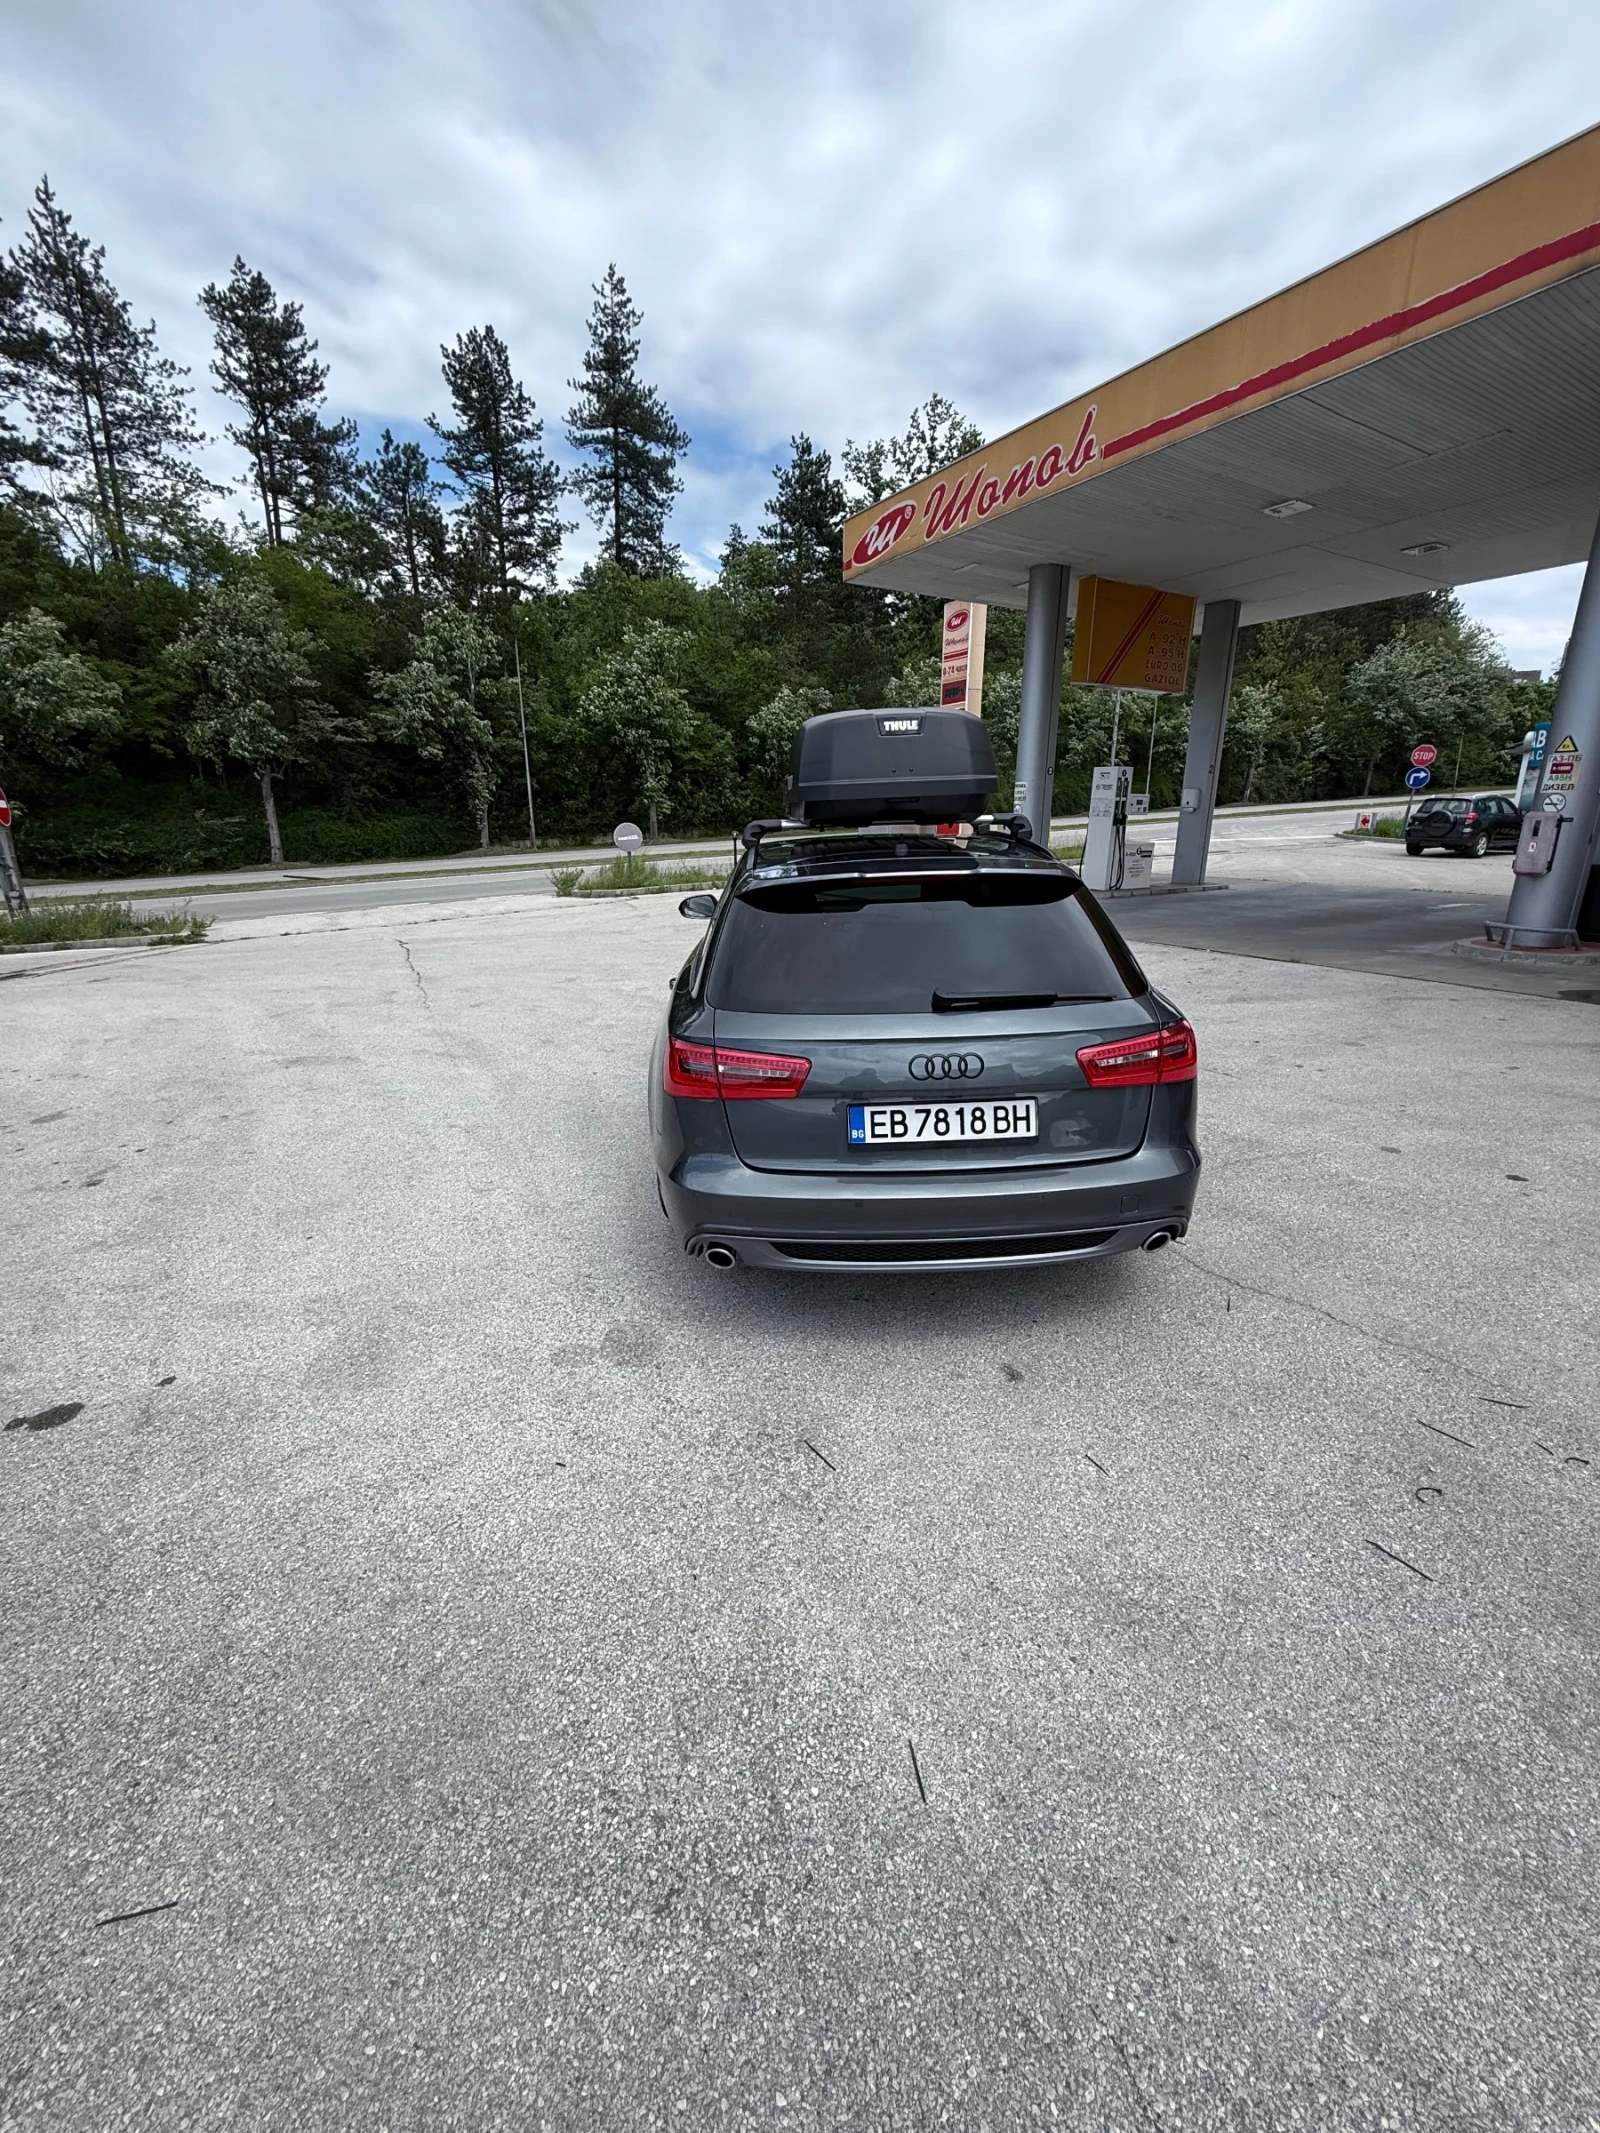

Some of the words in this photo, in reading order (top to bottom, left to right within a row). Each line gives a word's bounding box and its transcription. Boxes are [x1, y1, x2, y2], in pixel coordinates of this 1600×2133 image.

[1146, 660, 1169, 671] EURO
[1144, 673, 1181, 686] GAZIOL
[883, 720, 918, 731] THULE
[1413, 751, 1434, 760] STOP
[1208, 764, 1214, 774] 2
[1542, 784, 1575, 792] ДИЗЕЛ
[870, 1110, 908, 1139] EB
[915, 1107, 987, 1137] 7818
[993, 1105, 1031, 1134] BH
[852, 1130, 865, 1138] BG
